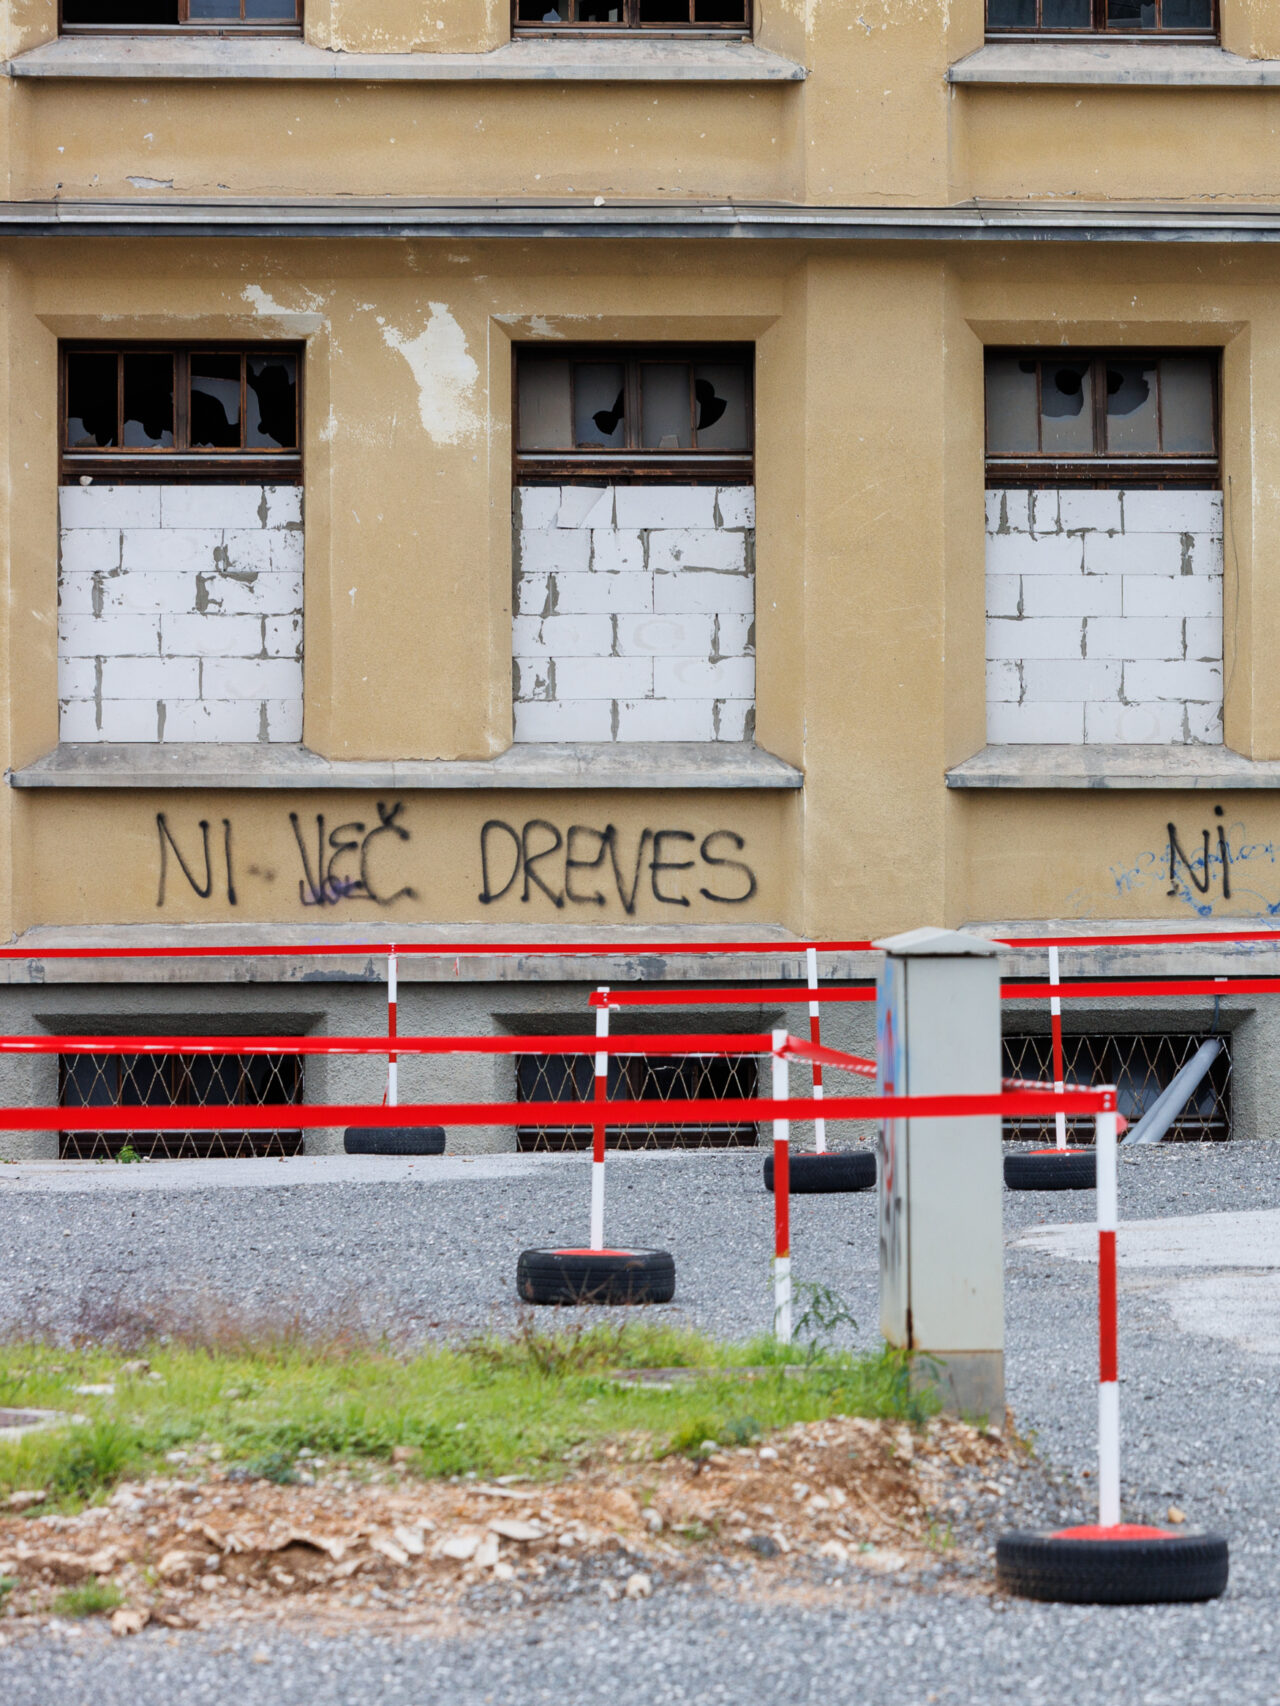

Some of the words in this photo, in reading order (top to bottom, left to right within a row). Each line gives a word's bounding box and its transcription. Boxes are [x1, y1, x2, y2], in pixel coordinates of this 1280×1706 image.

[156, 812, 237, 907] NI
[289, 802, 418, 906] VEČ
[478, 819, 758, 915] DREVES
